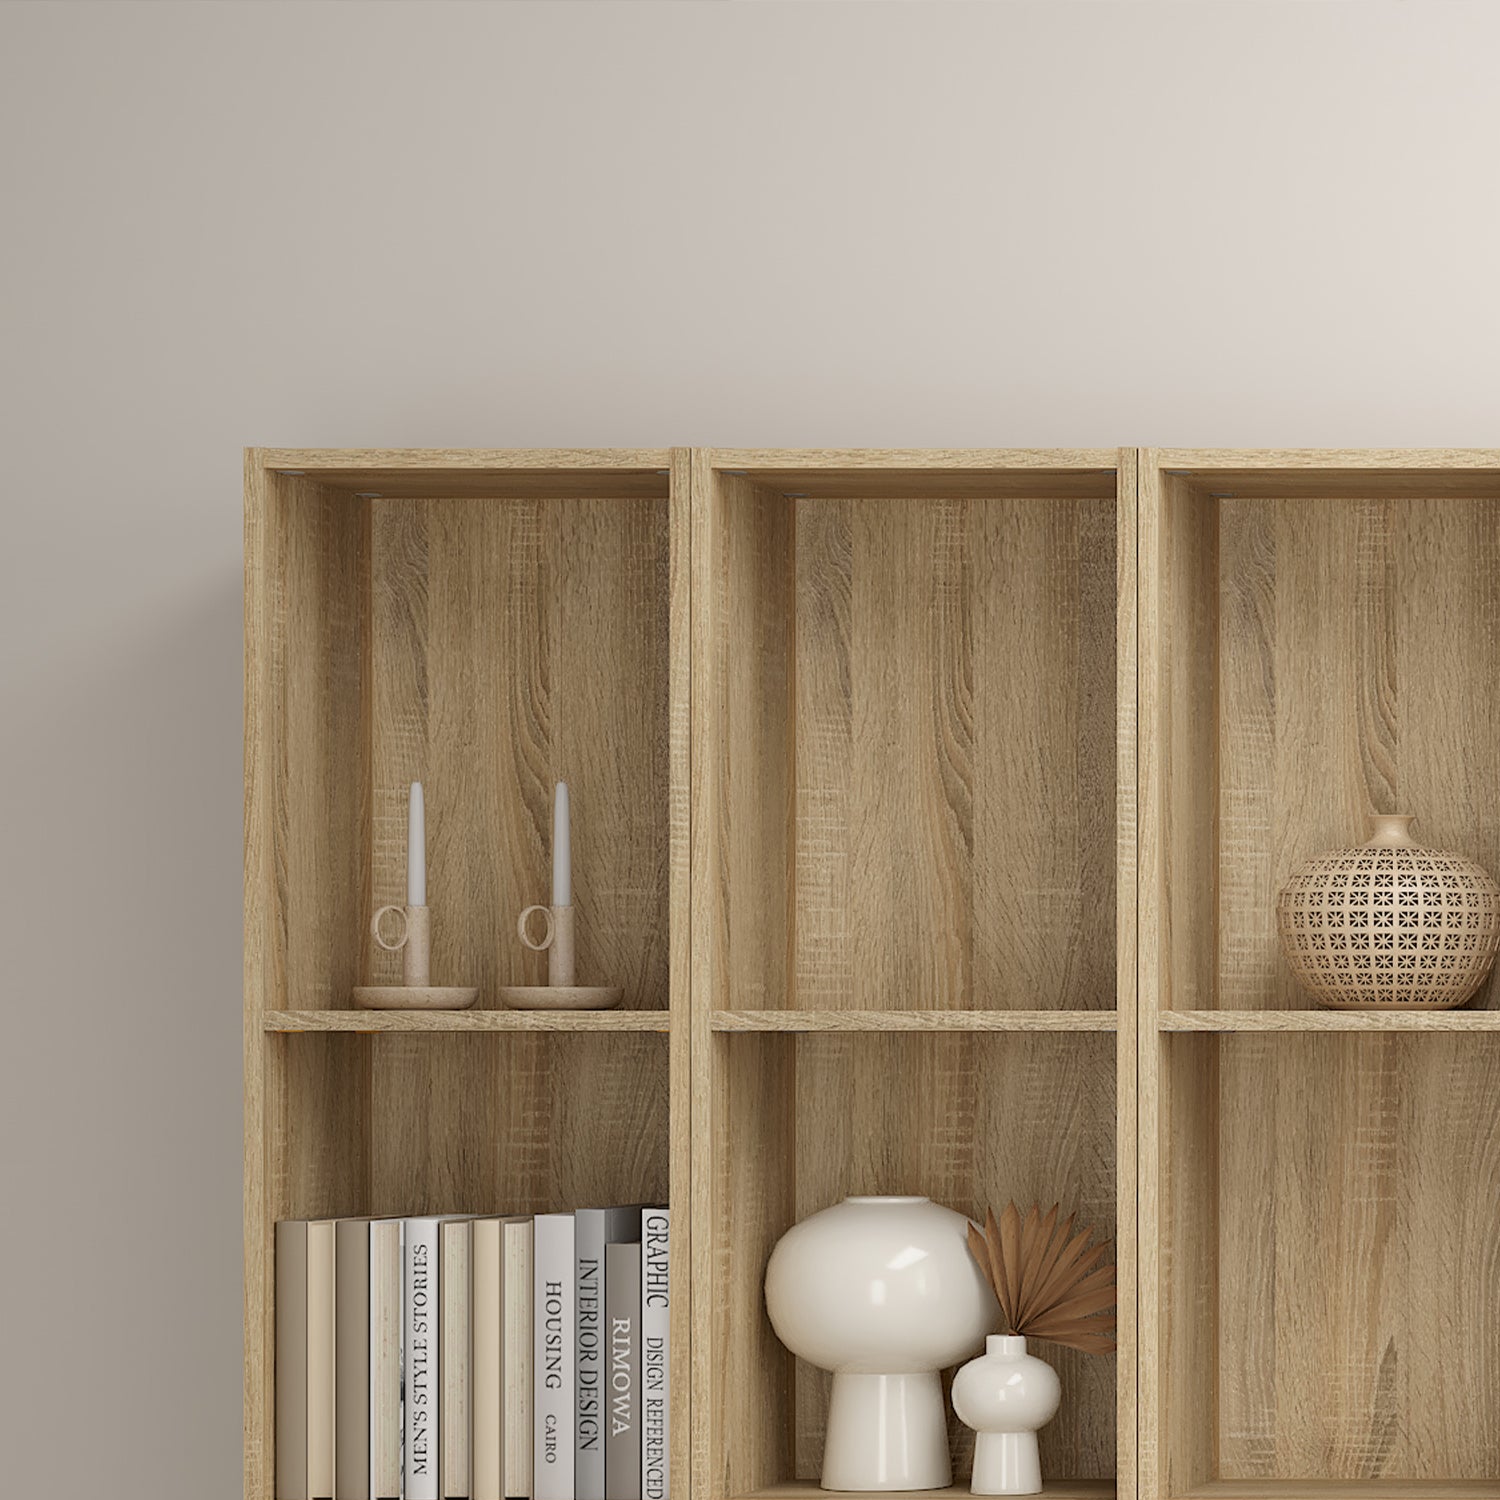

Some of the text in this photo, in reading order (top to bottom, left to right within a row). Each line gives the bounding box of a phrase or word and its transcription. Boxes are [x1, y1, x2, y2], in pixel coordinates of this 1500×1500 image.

[413, 1242, 429, 1476] MEN'S STYLE STORIES
[545, 1279, 563, 1465] HOUSING CAIRO
[579, 1257, 599, 1453] INTERIOR DESIGN
[611, 1316, 632, 1438] RIMOWA
[646, 1215, 669, 1500] GRAPHIC DISIGN REFERENCED
